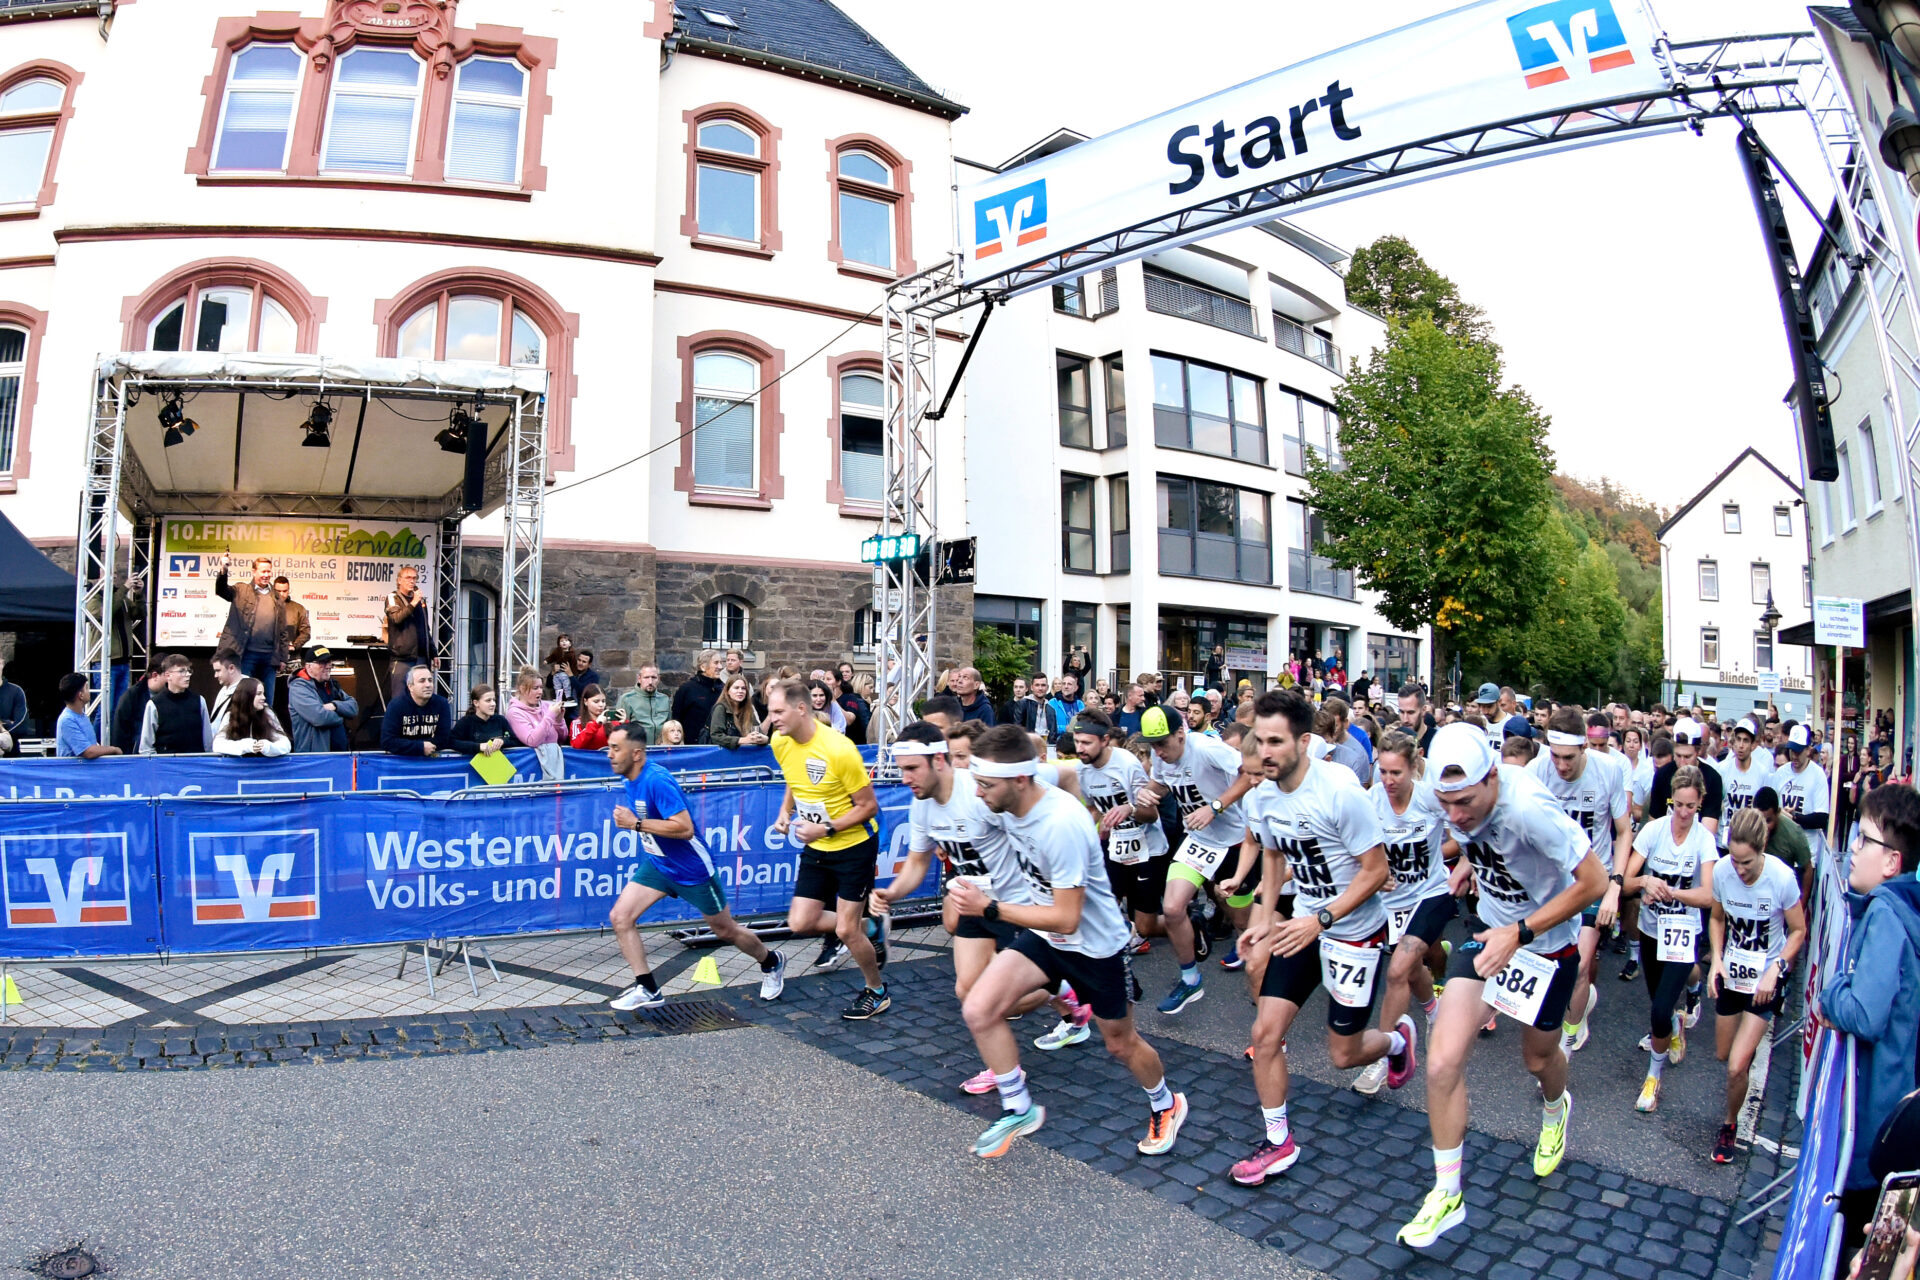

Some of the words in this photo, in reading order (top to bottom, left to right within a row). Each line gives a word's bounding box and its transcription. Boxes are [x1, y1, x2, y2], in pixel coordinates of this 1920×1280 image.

[1167, 79, 1362, 195] Start
[285, 529, 432, 558] Westerwald
[207, 555, 280, 568] Wsterld
[286, 557, 316, 569] Bank
[320, 559, 337, 569] eG
[346, 561, 394, 582] BETZDORF
[206, 568, 237, 578] Vos-
[270, 568, 336, 580] iffeisenbank
[1719, 671, 1806, 689] Blindenstätte
[1727, 792, 1754, 809] WE
[1781, 794, 1805, 813] WE
[366, 819, 638, 871] Westerwald
[705, 814, 752, 852] nk
[1115, 838, 1141, 856] 570
[1187, 843, 1218, 864] 576
[1272, 837, 1327, 867] WE
[1383, 837, 1430, 860] WE
[366, 874, 479, 910] Volks-
[492, 867, 561, 903] und
[574, 854, 801, 898] Raifnban
[1291, 862, 1334, 887] UN
[1726, 914, 1770, 938] WE
[1664, 928, 1690, 948] 575
[1328, 958, 1367, 988] 574
[1495, 963, 1539, 1000] 584
[1729, 961, 1758, 980] 586
